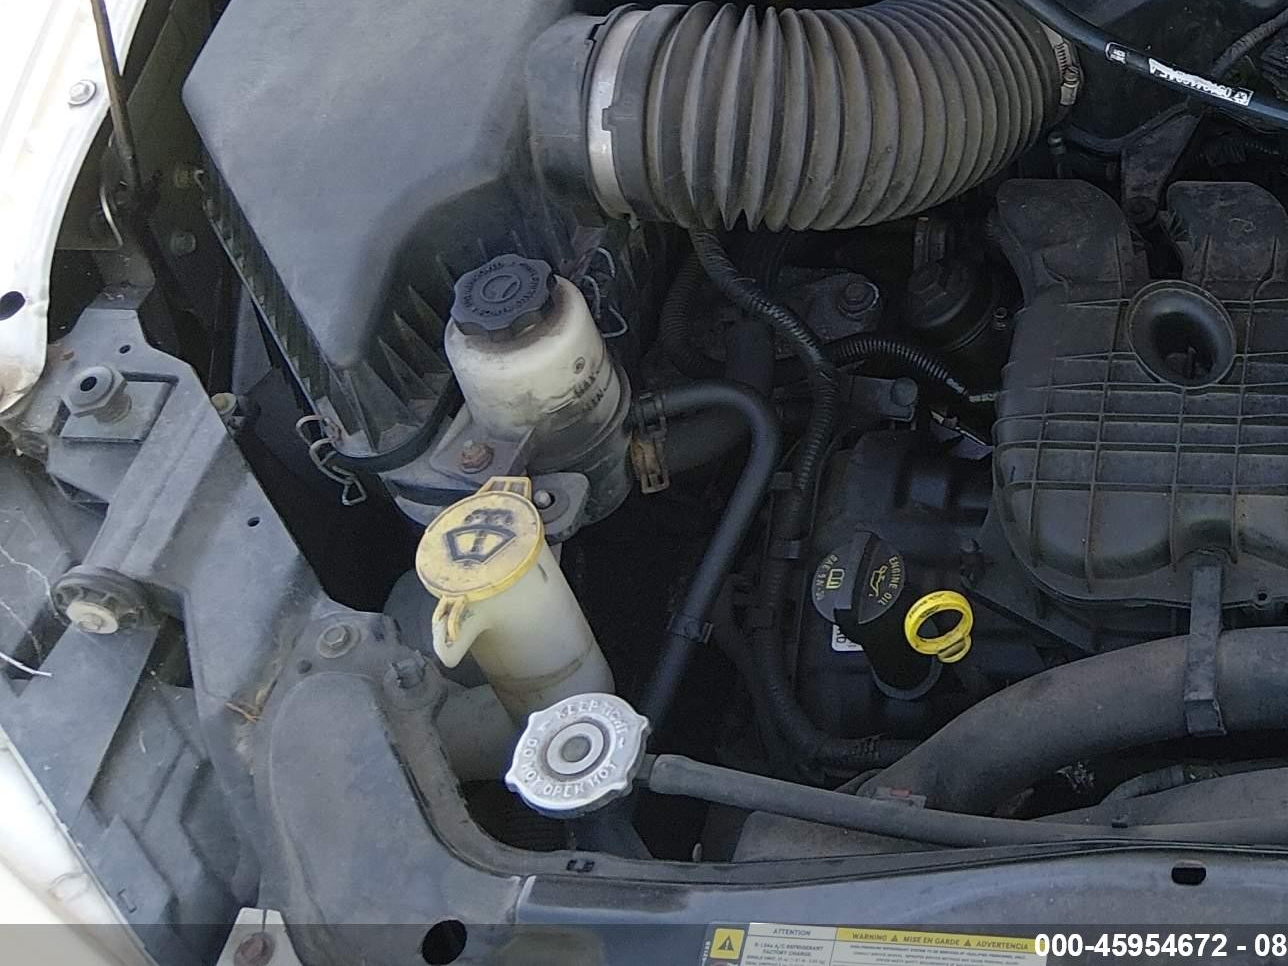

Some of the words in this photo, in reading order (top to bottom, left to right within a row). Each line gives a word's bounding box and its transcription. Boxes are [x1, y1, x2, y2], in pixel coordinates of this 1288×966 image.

[888, 555, 902, 590] ENGINE
[877, 592, 893, 606] OIL
[523, 737, 539, 758] DO
[520, 762, 545, 786] NOT
[588, 762, 618, 789] HOT
[543, 781, 586, 797] OPEN
[772, 928, 811, 936] ATTENTION
[851, 932, 888, 942] WARNING
[903, 936, 920, 944] MISE
[923, 937, 934, 945] EN
[935, 938, 960, 947] GARDE
[976, 940, 1029, 951] ADVERTENCIA
